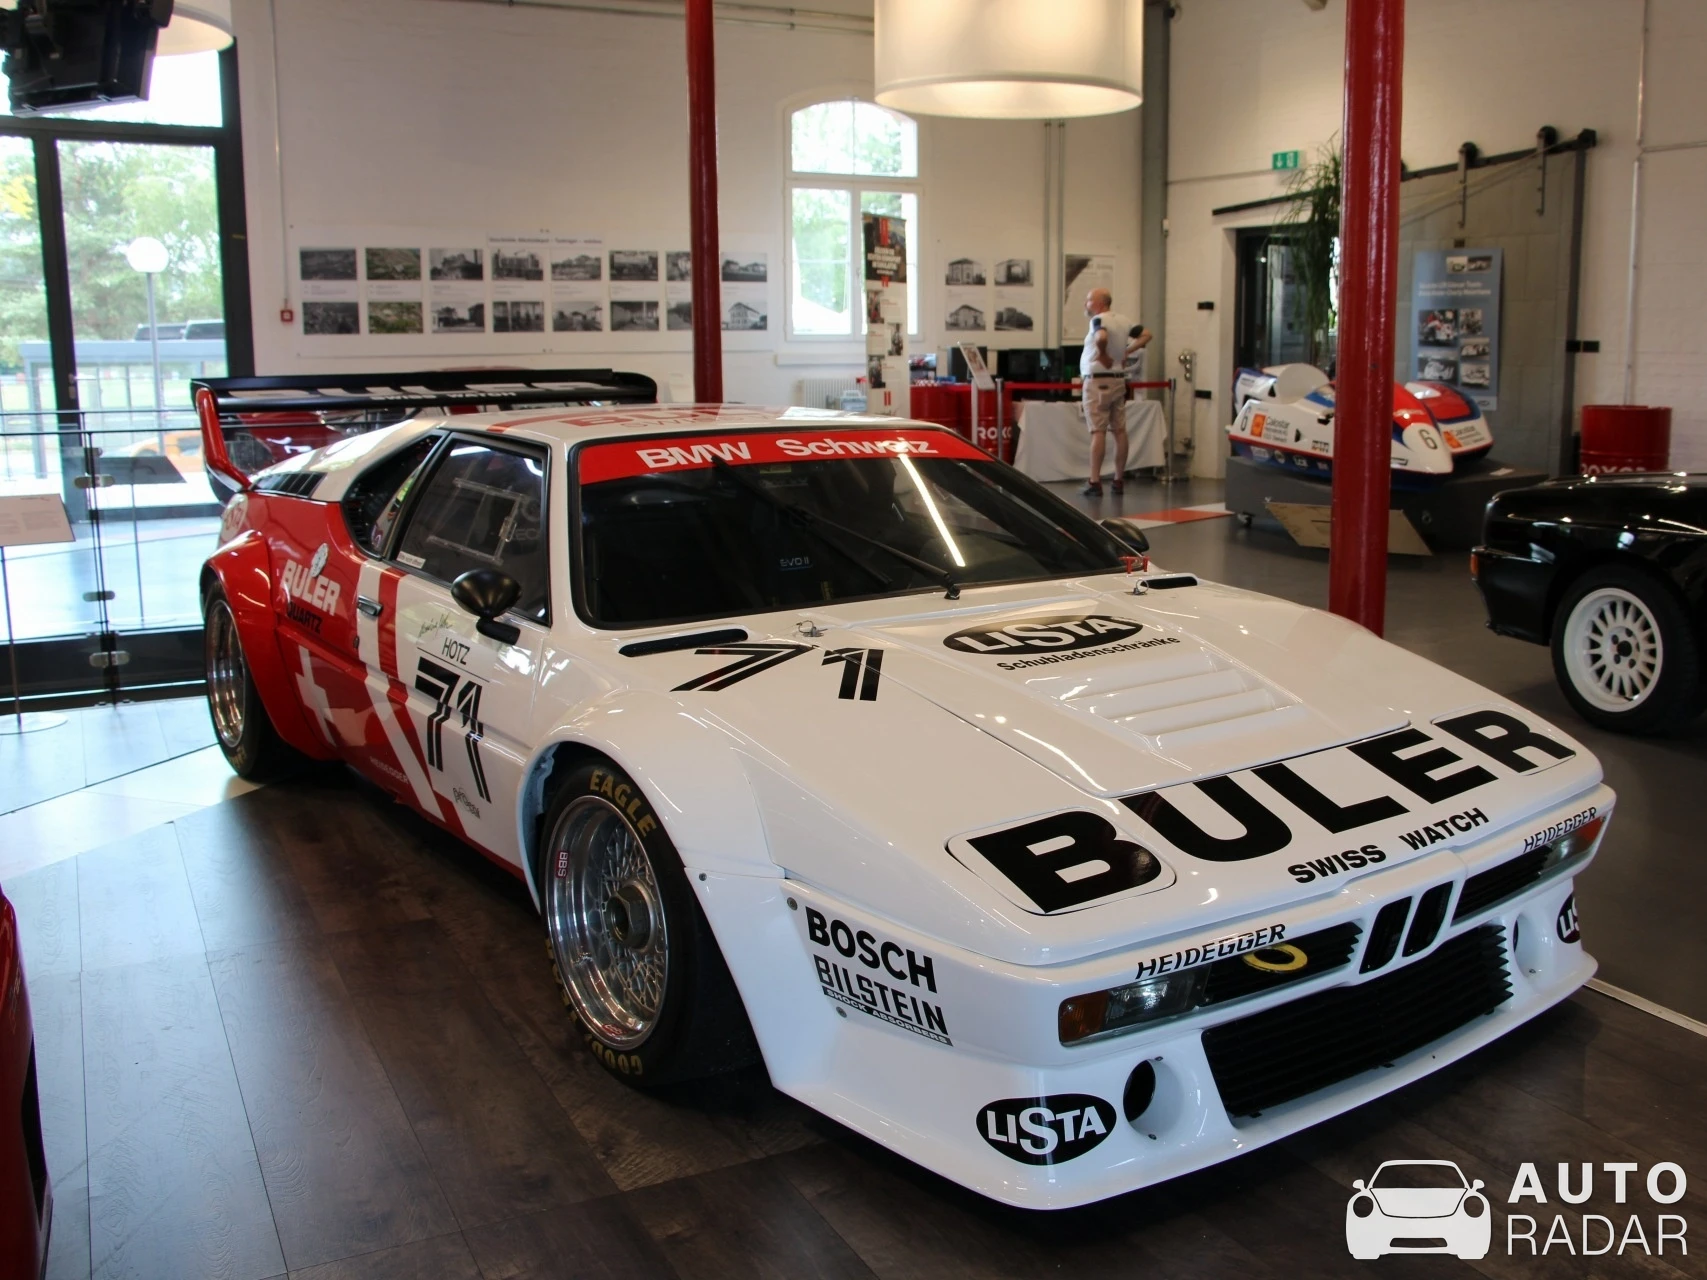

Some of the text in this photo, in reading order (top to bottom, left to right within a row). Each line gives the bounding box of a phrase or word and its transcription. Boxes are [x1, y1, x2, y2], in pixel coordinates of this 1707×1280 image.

[636, 436, 939, 468] BMW Schweiz
[1418, 429, 1438, 450] 6
[280, 558, 341, 616] BULER
[287, 601, 323, 634] QUARTZ
[953, 617, 1137, 652] LISTA
[441, 637, 471, 665] HOTZ
[669, 643, 885, 702] 71
[996, 636, 1181, 671] Schubladenschränke
[415, 656, 492, 804] 71
[589, 769, 658, 837] EAGLE
[966, 710, 1577, 914] BULER
[1523, 806, 1598, 853] HEIDEGGER
[558, 852, 569, 877] BBS
[1287, 807, 1490, 884] SWISS WATCH
[805, 906, 938, 994] BOSCH
[1135, 923, 1286, 980] HEIDEGGER
[813, 954, 949, 1036] BILSTEIN
[825, 989, 949, 1044] SHOCK ABSORBERS
[986, 1105, 1108, 1156] LISTA
